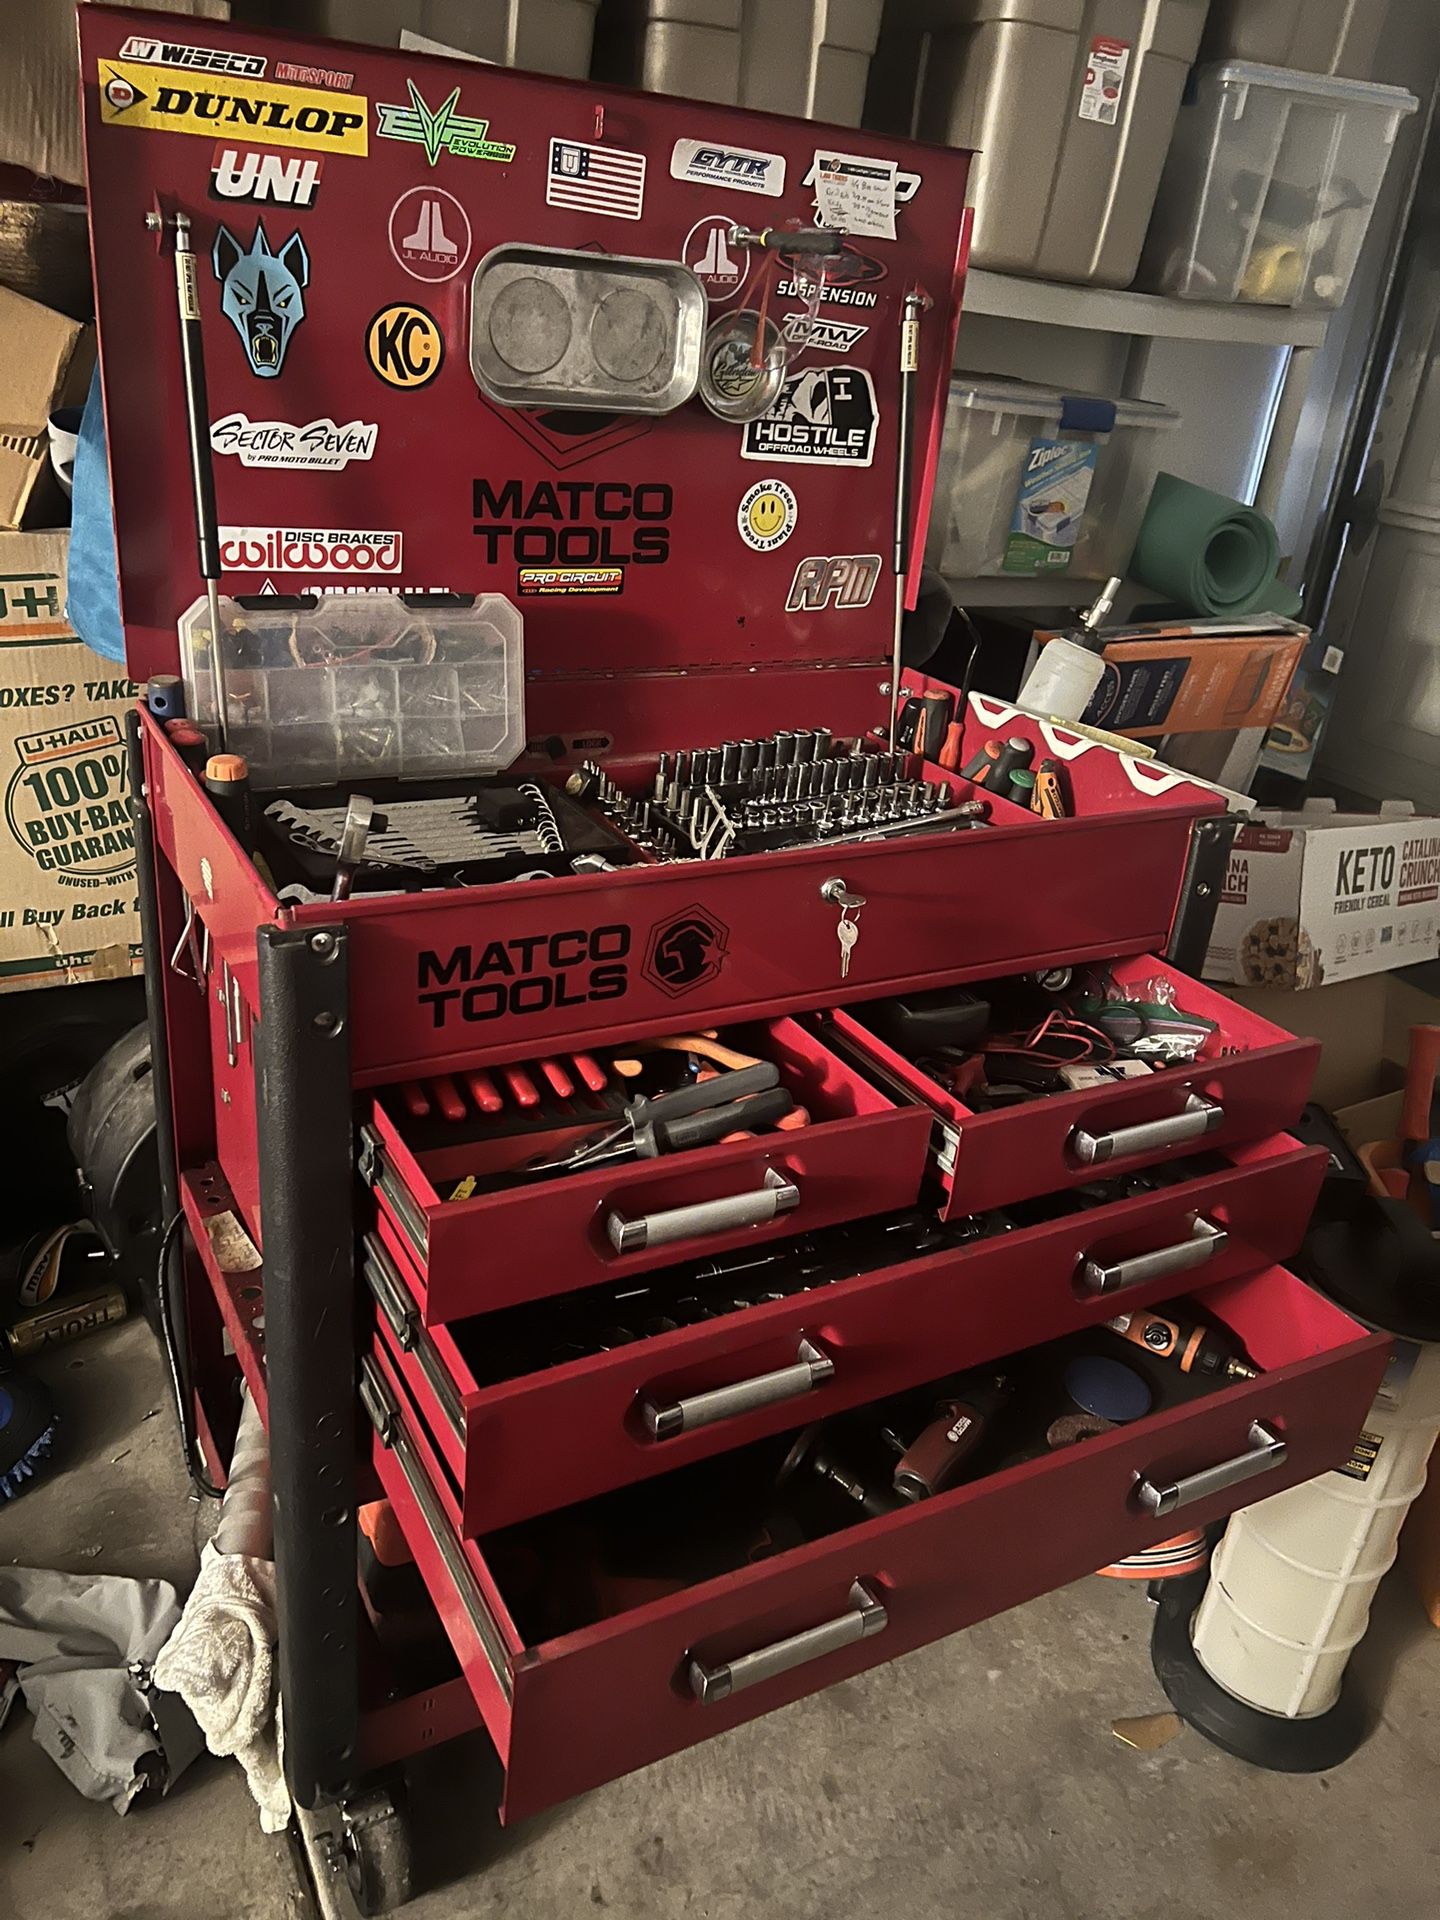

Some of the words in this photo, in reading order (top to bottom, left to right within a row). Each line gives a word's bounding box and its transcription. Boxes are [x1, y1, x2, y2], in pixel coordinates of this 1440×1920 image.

[151, 87, 364, 137] DUNLOP
[453, 138, 513, 154] EVOLUTION
[211, 149, 319, 204] UNI
[686, 169, 732, 183] PERFORMANCE
[733, 178, 765, 189] PRODUCTS
[402, 249, 417, 260] JL
[419, 253, 458, 265] AUDIO
[707, 274, 738, 284] AUDIO
[777, 281, 877, 307] SUSPENSION
[377, 312, 431, 381] KC
[755, 422, 866, 446] HOSTILE
[247, 454, 257, 462] by
[257, 455, 279, 463] PRO
[279, 456, 308, 464] MOTO
[758, 443, 812, 454] OFFROAD
[813, 446, 859, 457] WHEELS
[473, 479, 673, 520] MATCO
[741, 483, 773, 513] Smoke
[774, 482, 794, 511] Trees
[284, 532, 325, 543] DISC
[327, 534, 394, 545] BRAKES
[474, 525, 670, 565] TOOLS
[743, 525, 766, 549] Trees
[767, 523, 793, 547] Plant
[221, 530, 401, 570] wilwood
[522, 573, 558, 584] PRO
[559, 572, 619, 584] CIRCUIT
[84, 680, 139, 701] TAKE
[23, 722, 113, 754] U-HAUL
[25, 796, 134, 846] BUY-BA
[35, 827, 135, 871] GUARAN
[1335, 845, 1396, 897] KETO
[22, 908, 65, 926] Buy
[71, 899, 126, 921] Back
[1333, 897, 1366, 915] FRIENDLY
[1366, 893, 1391, 909] CEREAL
[417, 924, 631, 988] MATCO
[417, 964, 628, 1028] TOOLS
